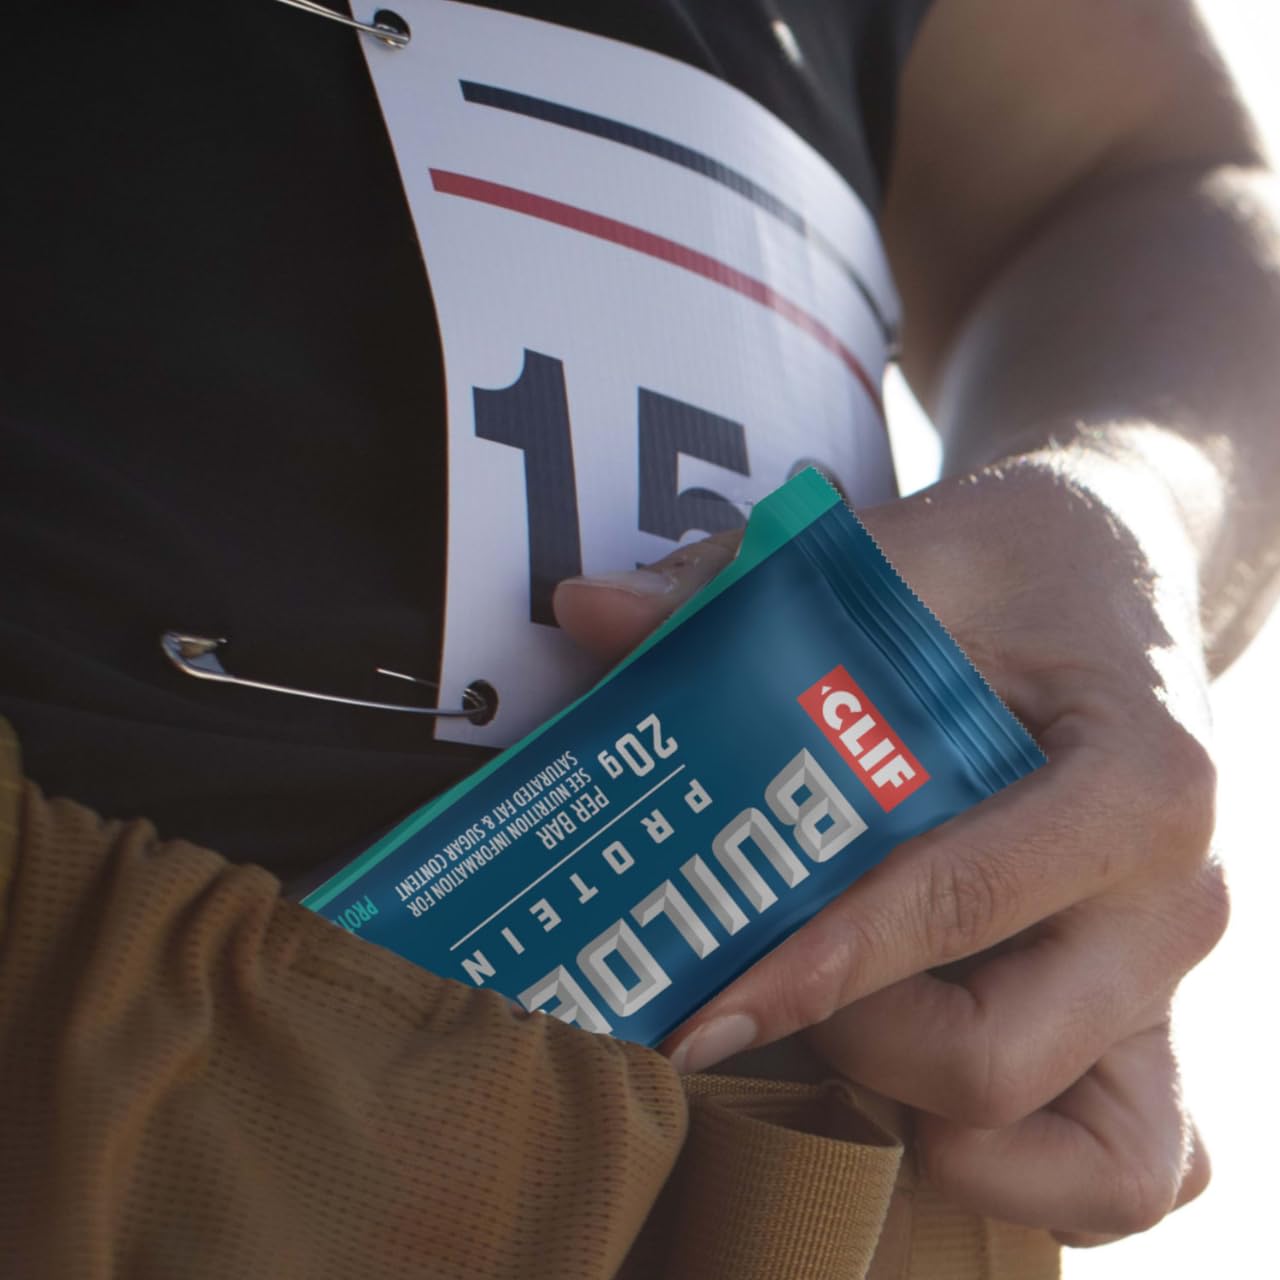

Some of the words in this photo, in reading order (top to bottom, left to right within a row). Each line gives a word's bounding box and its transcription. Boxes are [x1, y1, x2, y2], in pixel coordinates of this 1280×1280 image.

[597, 713, 679, 779] 20g
[822, 686, 916, 789] CLIF
[512, 750, 578, 807] SATURATED
[565, 768, 592, 793] SEE
[480, 815, 495, 830] &
[492, 799, 517, 824] FAT
[506, 783, 572, 840] NUTRITION
[569, 785, 610, 822] PER
[443, 823, 486, 861] SUGAR
[536, 811, 577, 850] BAR
[395, 854, 448, 902] CONTENT
[430, 831, 512, 900] INFORMATION
[461, 778, 713, 986] PROTEIN
[406, 890, 436, 917] FOR
